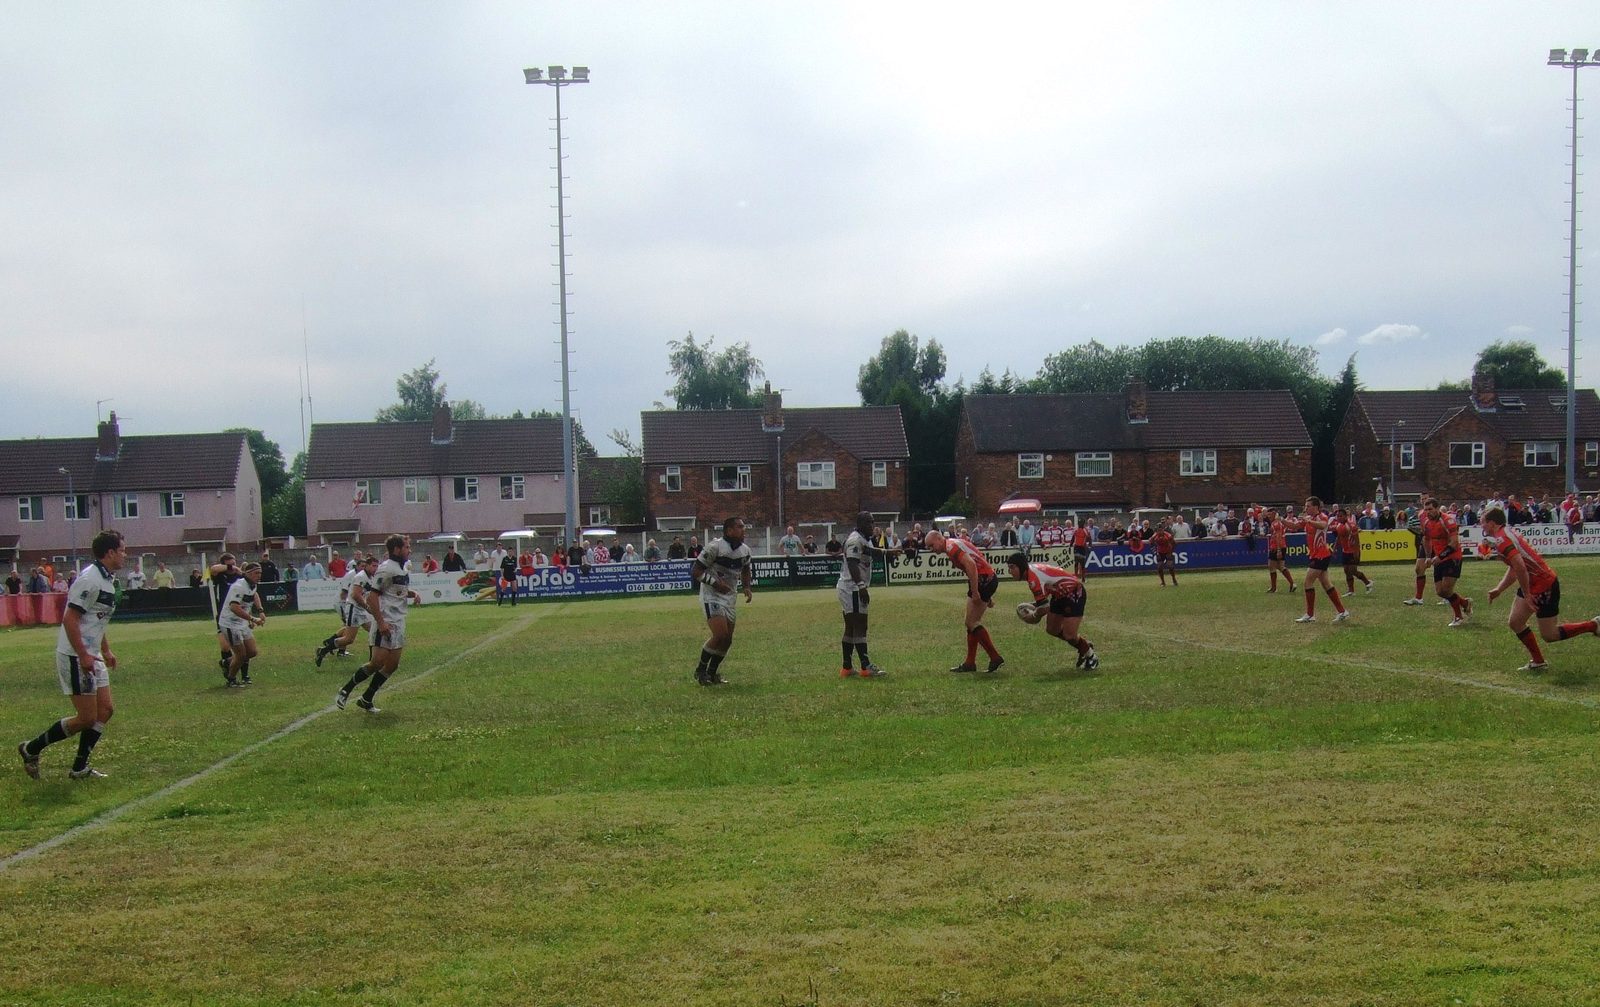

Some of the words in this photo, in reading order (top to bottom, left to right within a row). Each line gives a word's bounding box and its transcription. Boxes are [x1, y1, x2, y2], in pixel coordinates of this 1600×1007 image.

[1543, 526, 1564, 536] Cars
[1375, 540, 1409, 551] Shops
[1532, 537, 1553, 546] 0161
[754, 562, 781, 570] TIMBER
[783, 561, 789, 569] &
[913, 555, 923, 568] G
[595, 565, 626, 573] BUSINESSES
[627, 564, 648, 573] REQUIRE
[668, 562, 691, 570] SUPPORT
[755, 569, 790, 578] SUPPLIES
[891, 571, 923, 580] County
[926, 570, 945, 578] End.
[669, 581, 690, 589] 7250
